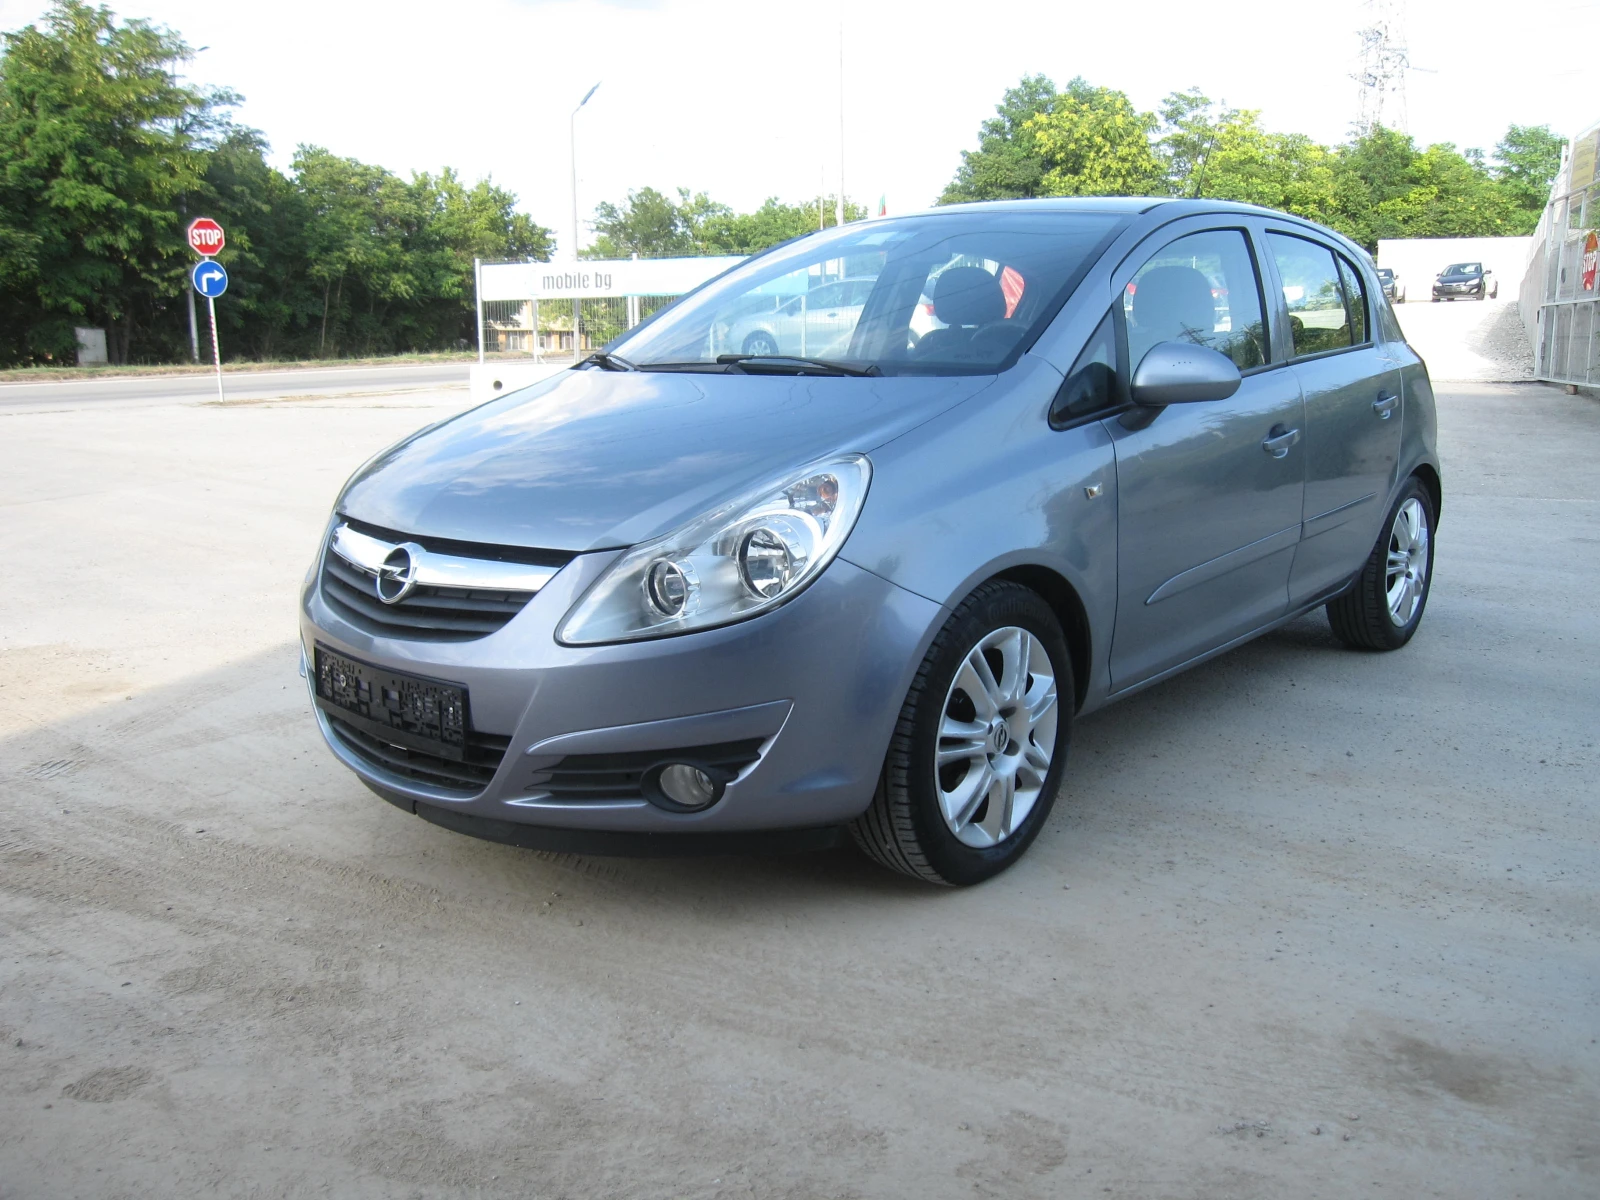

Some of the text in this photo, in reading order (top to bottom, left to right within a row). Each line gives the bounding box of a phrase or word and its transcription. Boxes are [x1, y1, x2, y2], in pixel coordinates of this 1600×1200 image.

[192, 229, 221, 246] STOP
[1583, 250, 1597, 274] STOP
[542, 271, 612, 290] mobile bg
